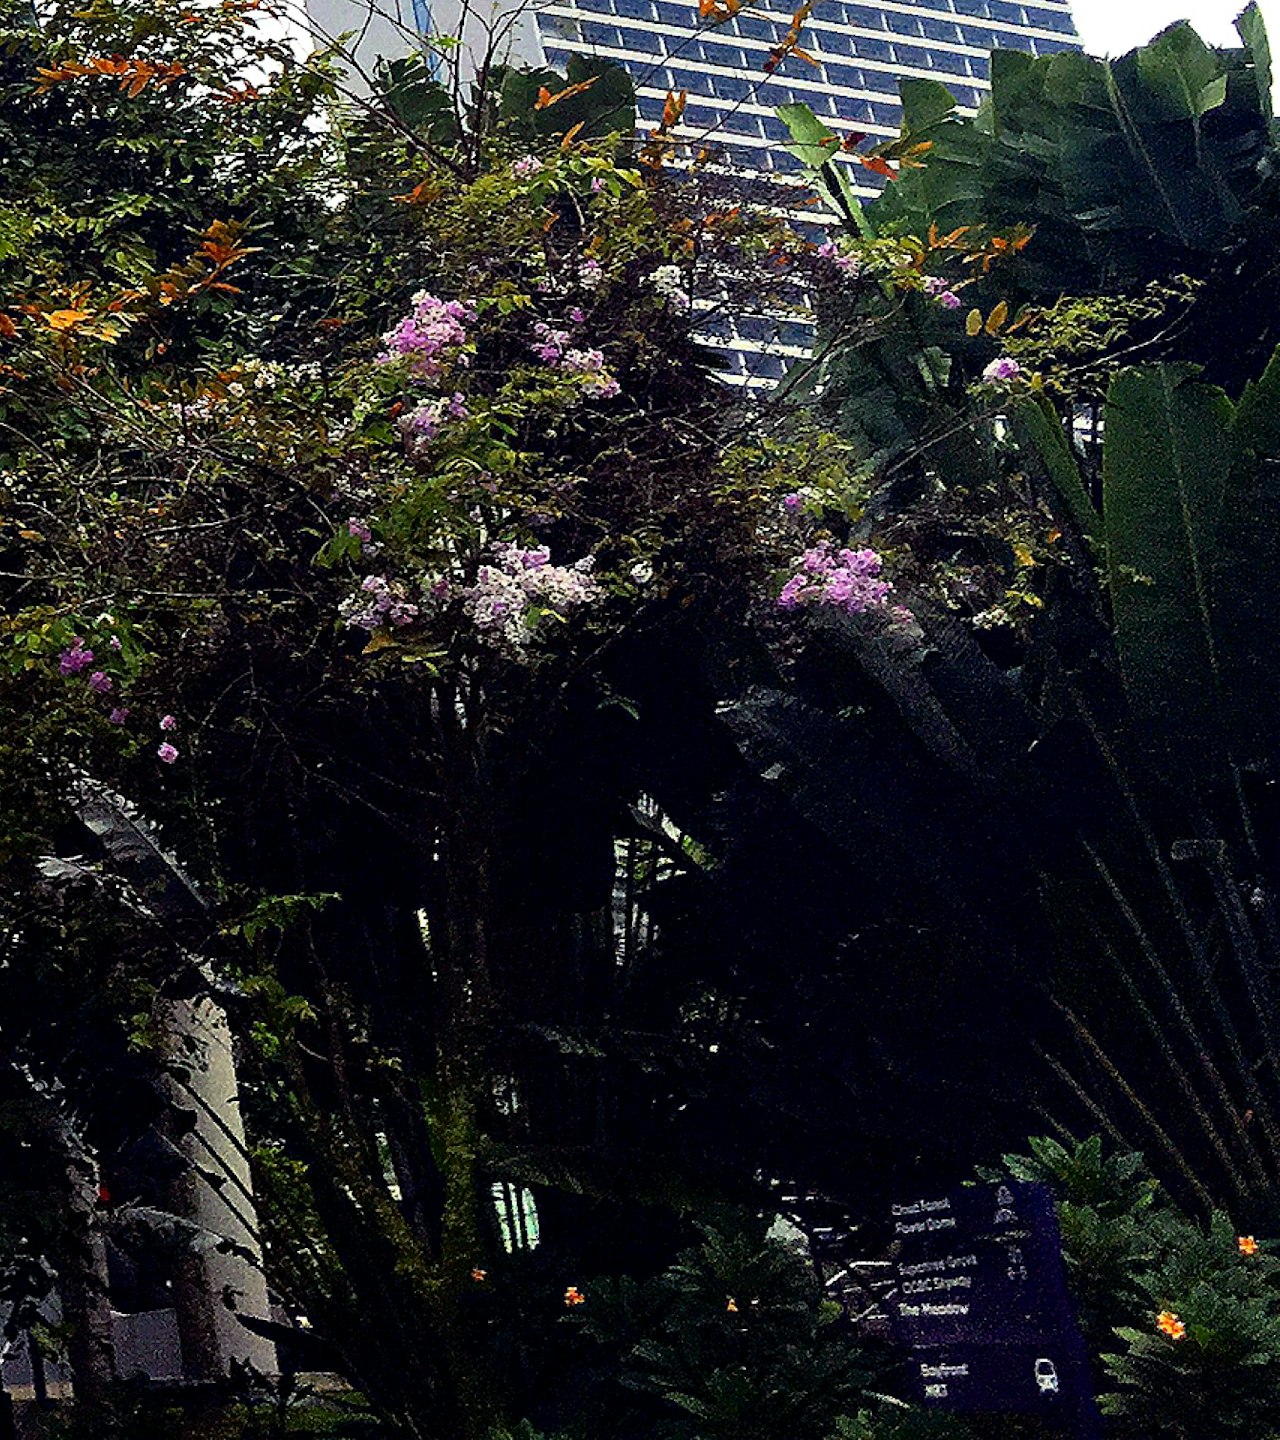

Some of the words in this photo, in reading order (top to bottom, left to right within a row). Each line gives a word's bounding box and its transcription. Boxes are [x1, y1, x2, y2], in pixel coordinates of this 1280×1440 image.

[897, 1302, 920, 1316] The
[921, 1301, 970, 1315] Meadow
[920, 1362, 969, 1380] Bayfront
